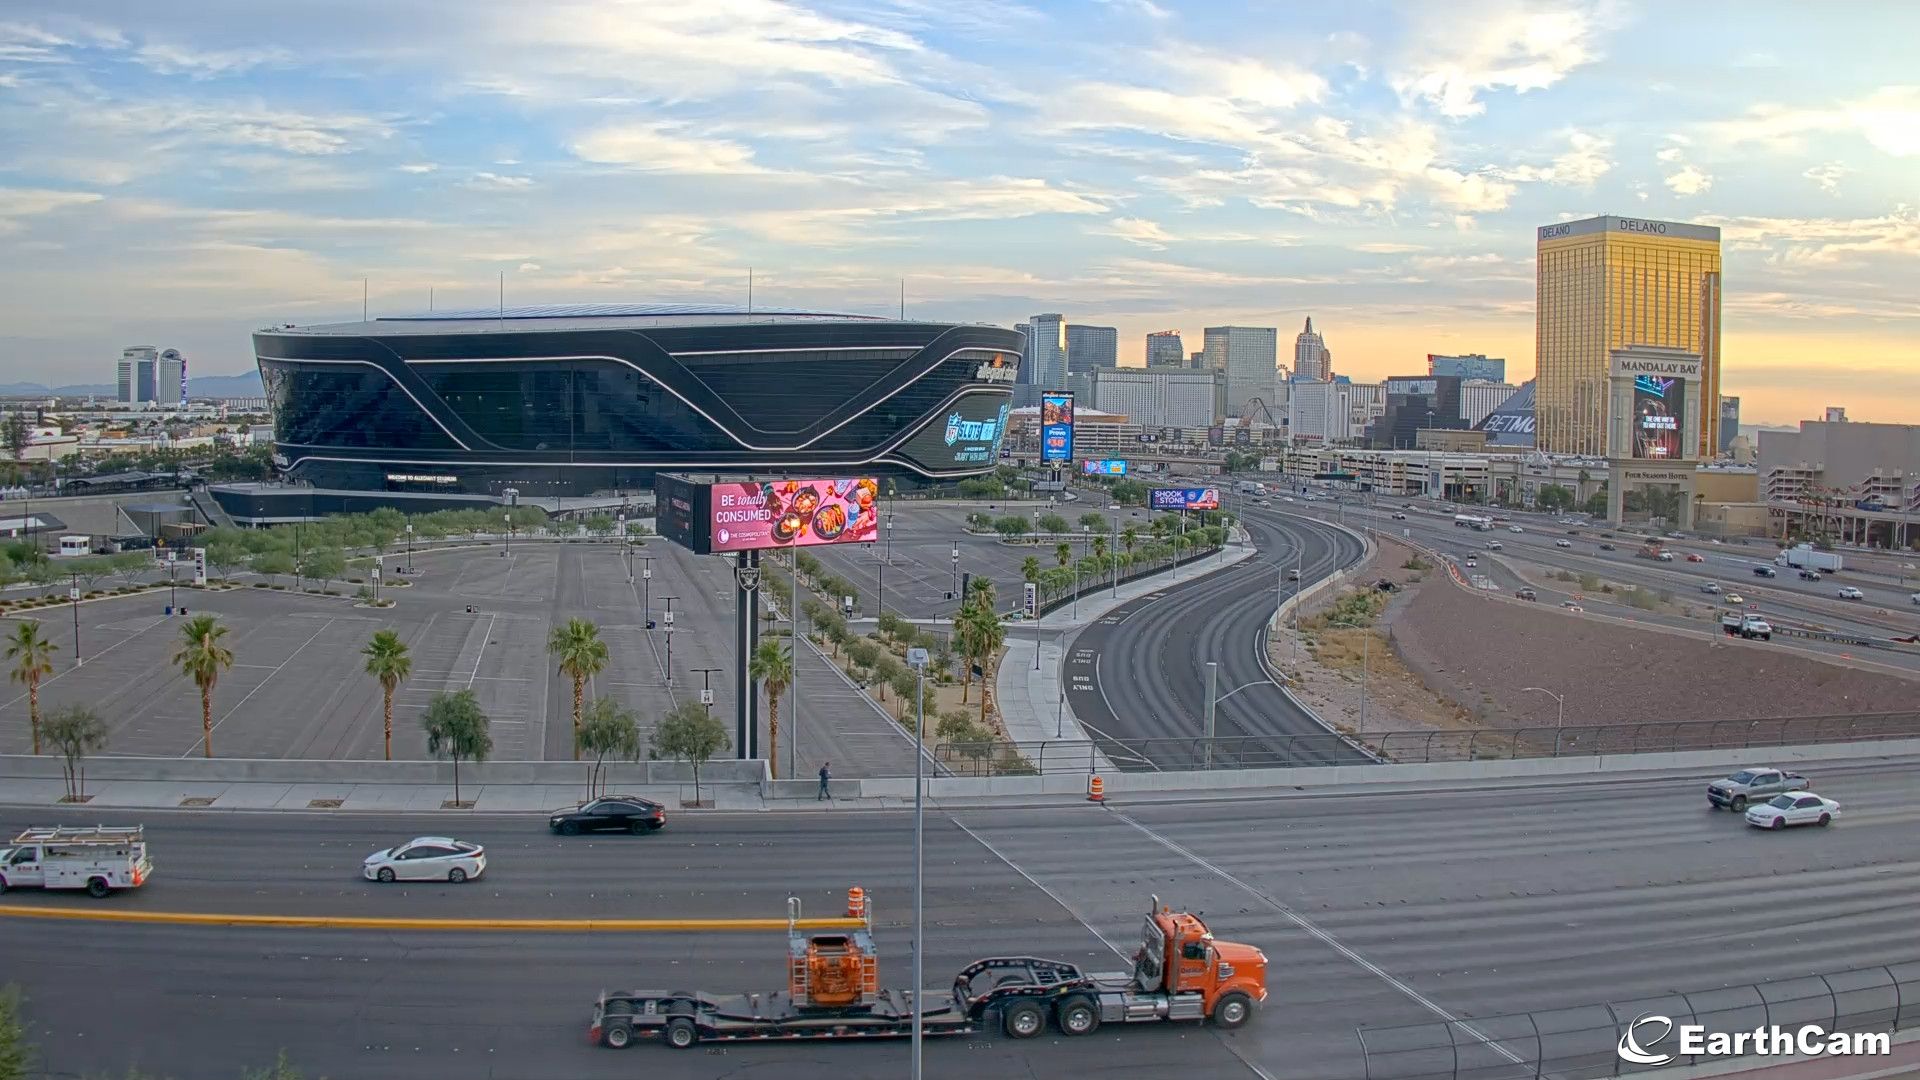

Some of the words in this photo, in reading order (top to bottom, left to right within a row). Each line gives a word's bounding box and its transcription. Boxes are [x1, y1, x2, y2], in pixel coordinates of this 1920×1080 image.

[1542, 224, 1570, 238] DELANO
[1620, 219, 1666, 234] DELANO
[1621, 361, 1678, 374] MANDALAY
[1680, 365, 1698, 374] BAY
[958, 423, 981, 439] SLOTS
[1668, 472, 1688, 480] HOTEL
[721, 495, 735, 506] BE
[737, 491, 768, 509] totally
[716, 509, 771, 523] CONSUMED
